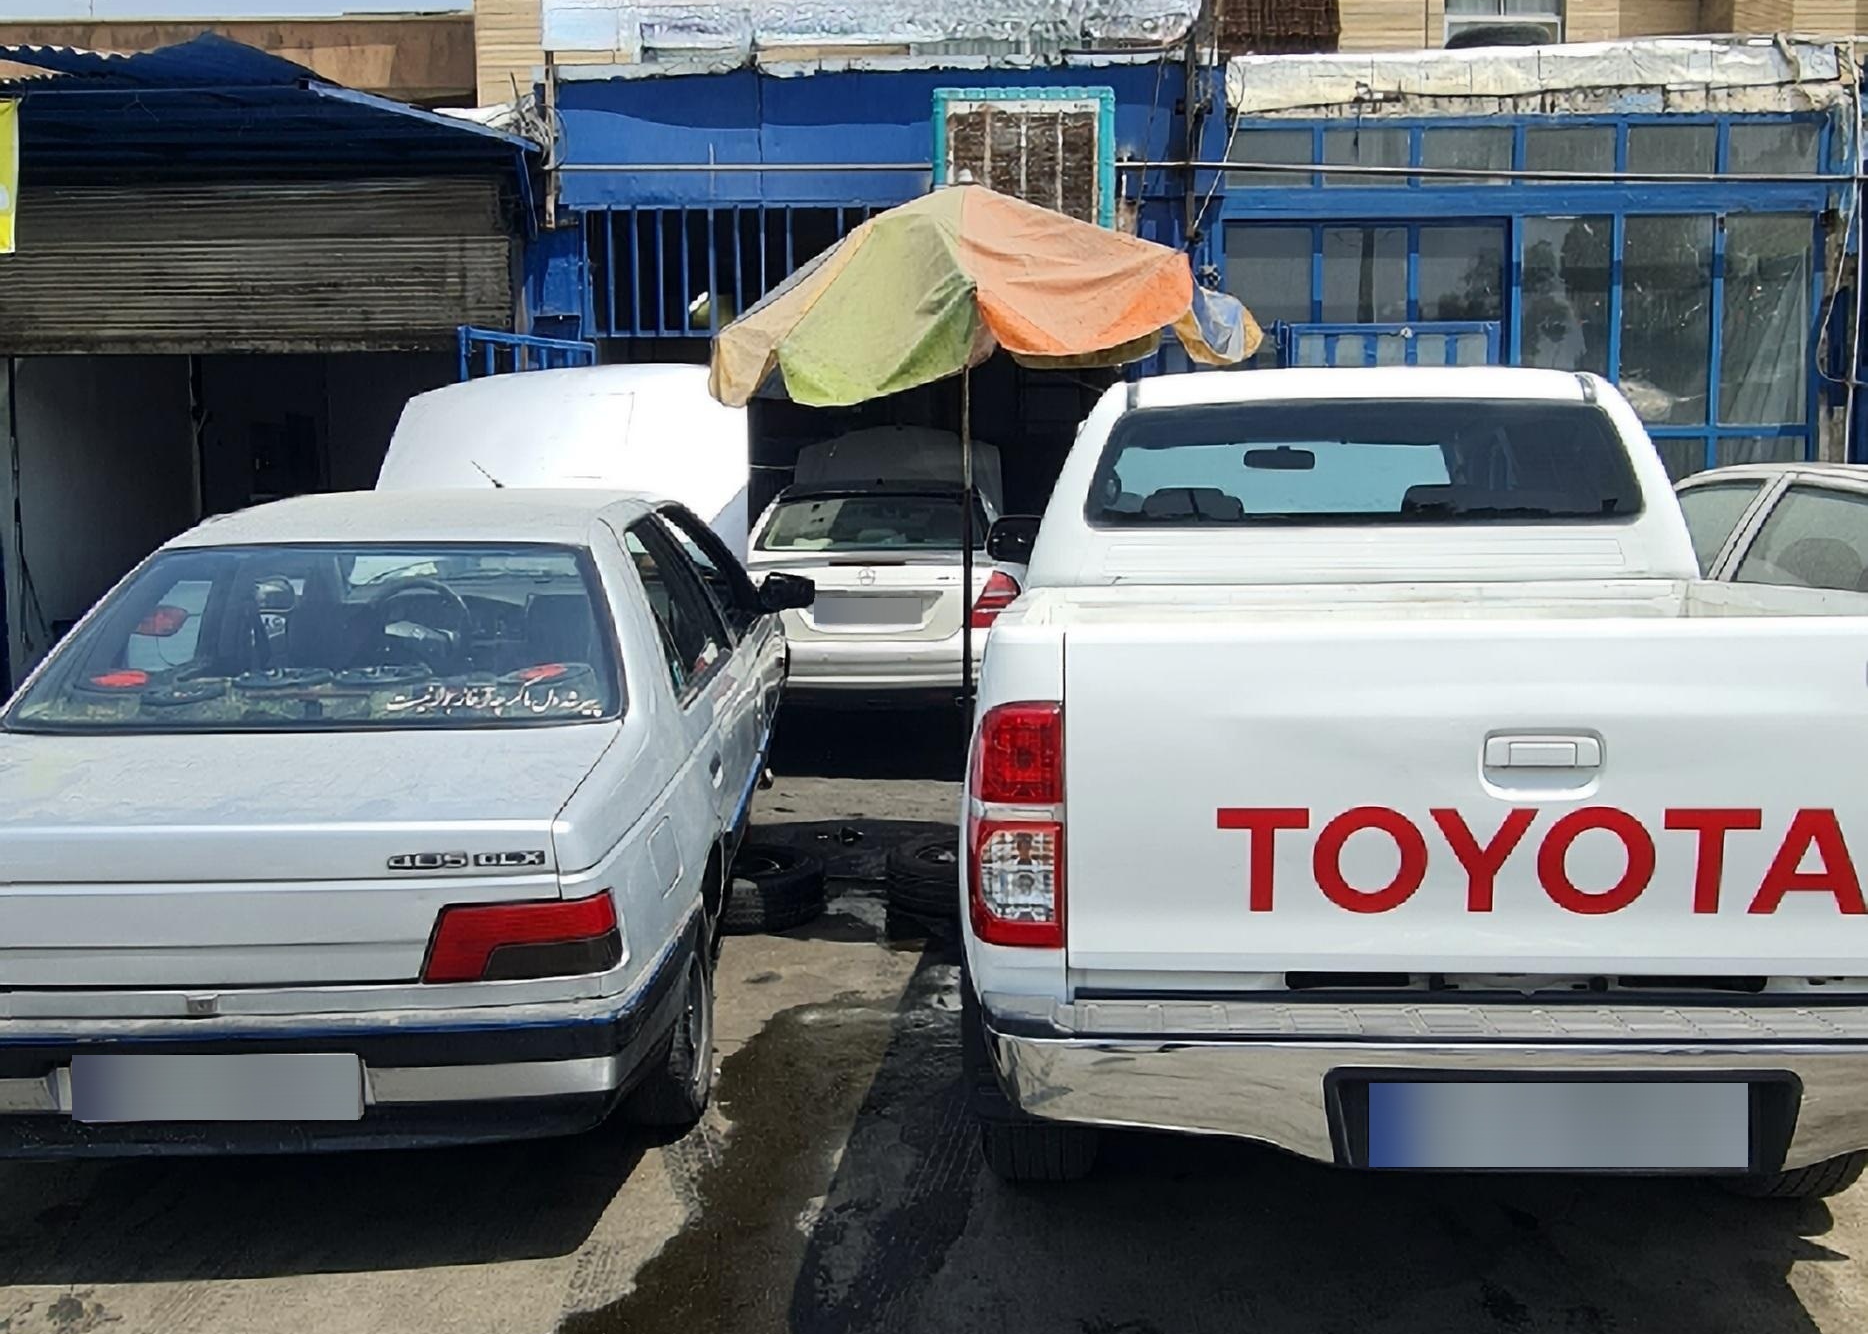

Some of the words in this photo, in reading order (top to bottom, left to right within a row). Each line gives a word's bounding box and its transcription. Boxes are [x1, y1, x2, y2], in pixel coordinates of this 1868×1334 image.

[387, 850, 468, 870] 405
[473, 850, 545, 867] GLX
[1216, 805, 1868, 916] TOYOTA
